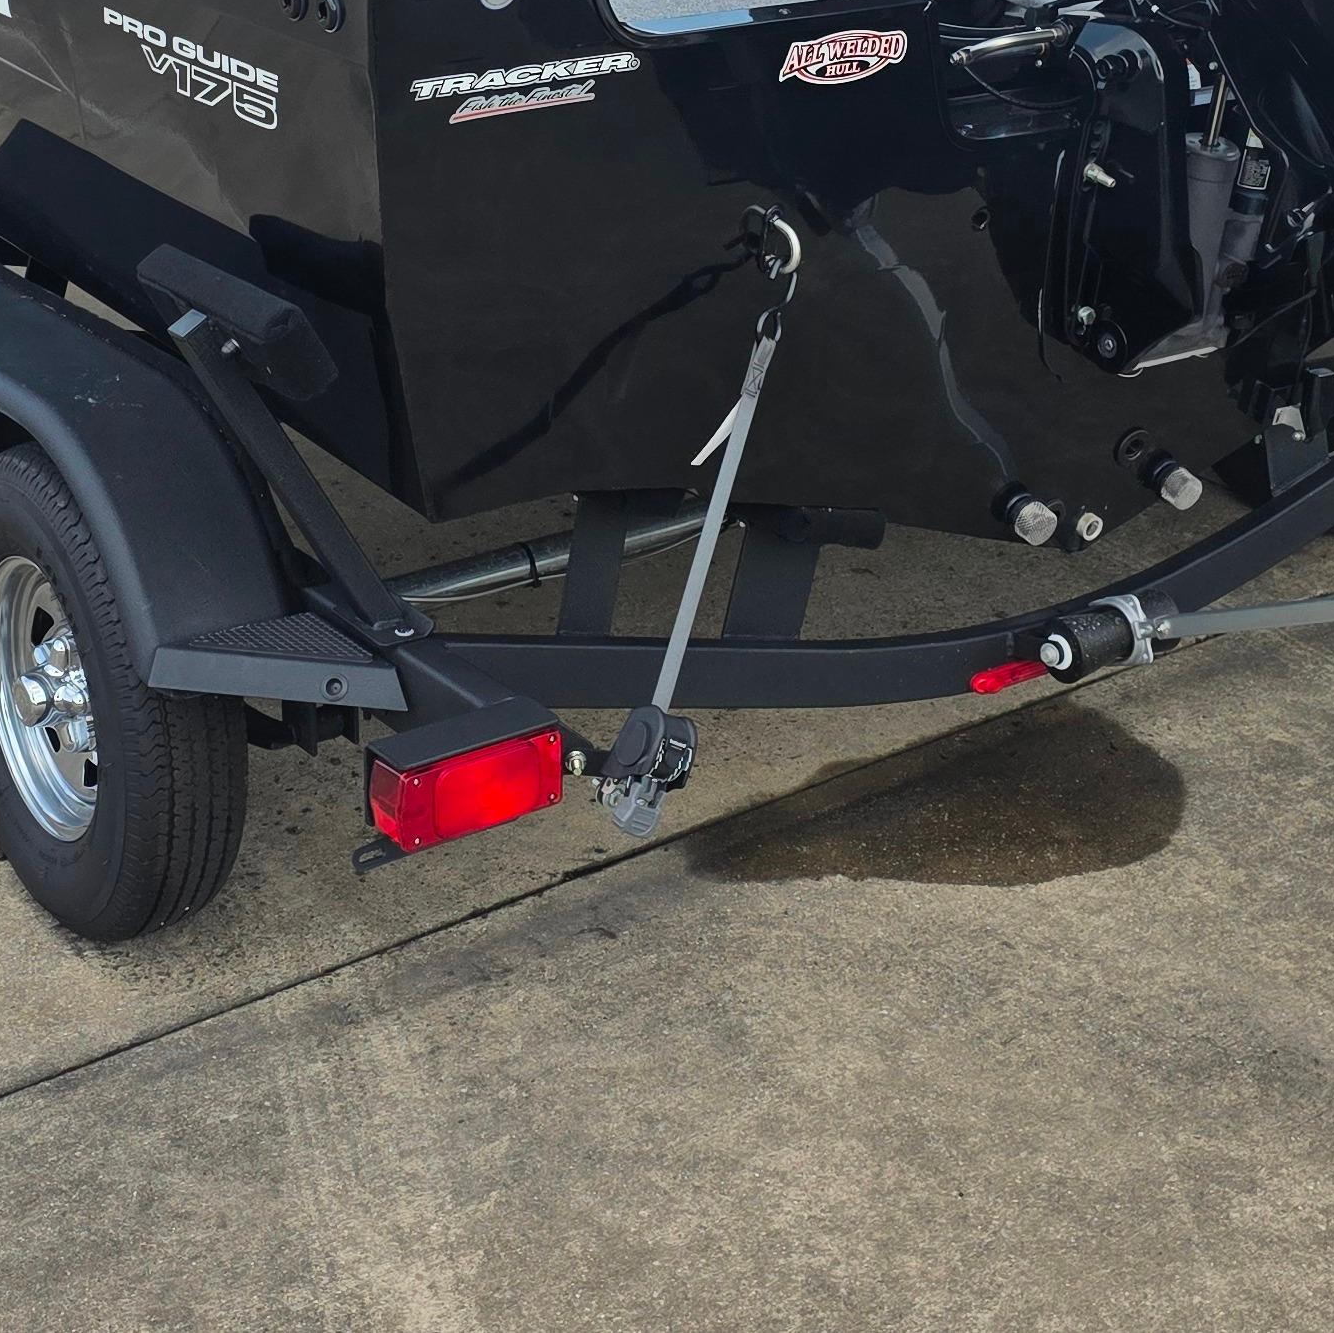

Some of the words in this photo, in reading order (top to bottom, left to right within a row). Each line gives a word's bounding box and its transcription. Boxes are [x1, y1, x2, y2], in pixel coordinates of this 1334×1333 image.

[104, 7, 167, 48] PRO
[173, 36, 279, 93] GUIDE
[784, 44, 825, 74] ALL
[827, 34, 904, 61] WELDED
[825, 62, 860, 76] HULL
[141, 44, 278, 130] V175
[414, 54, 634, 98] TRACKER
